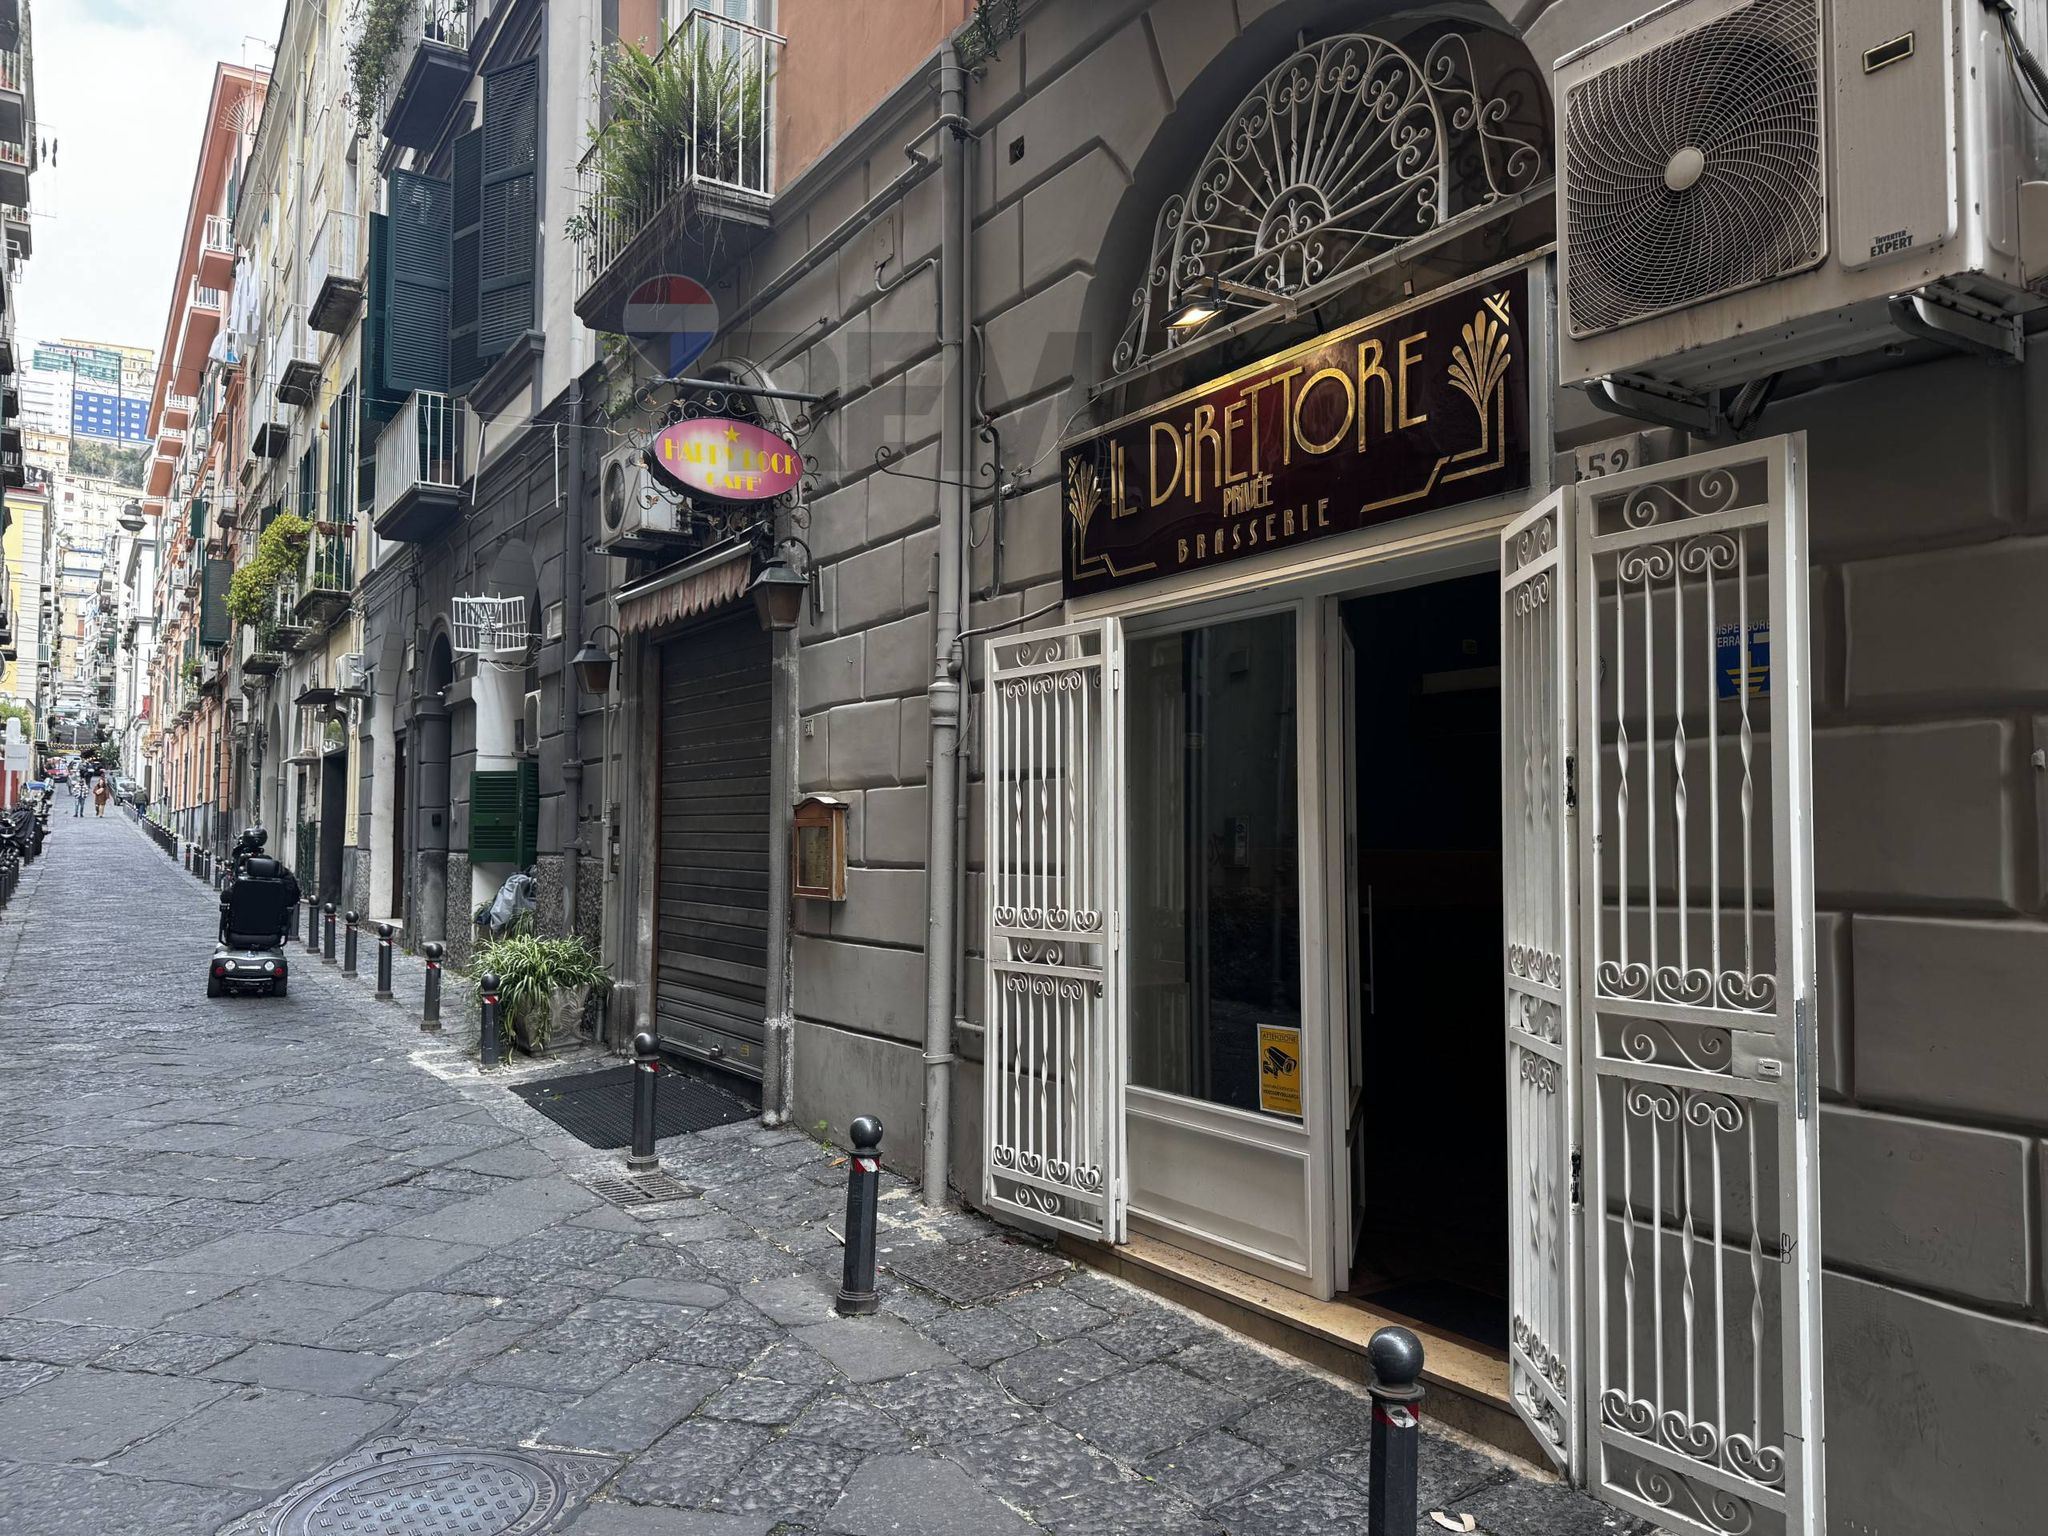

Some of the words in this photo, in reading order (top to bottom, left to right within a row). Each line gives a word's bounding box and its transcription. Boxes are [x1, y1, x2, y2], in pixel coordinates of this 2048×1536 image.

[1871, 235, 1913, 257] EXPERT
[664, 438, 738, 465] HAPPY
[1110, 439, 1138, 520] IL
[1177, 497, 1330, 564] BRASSERIE
